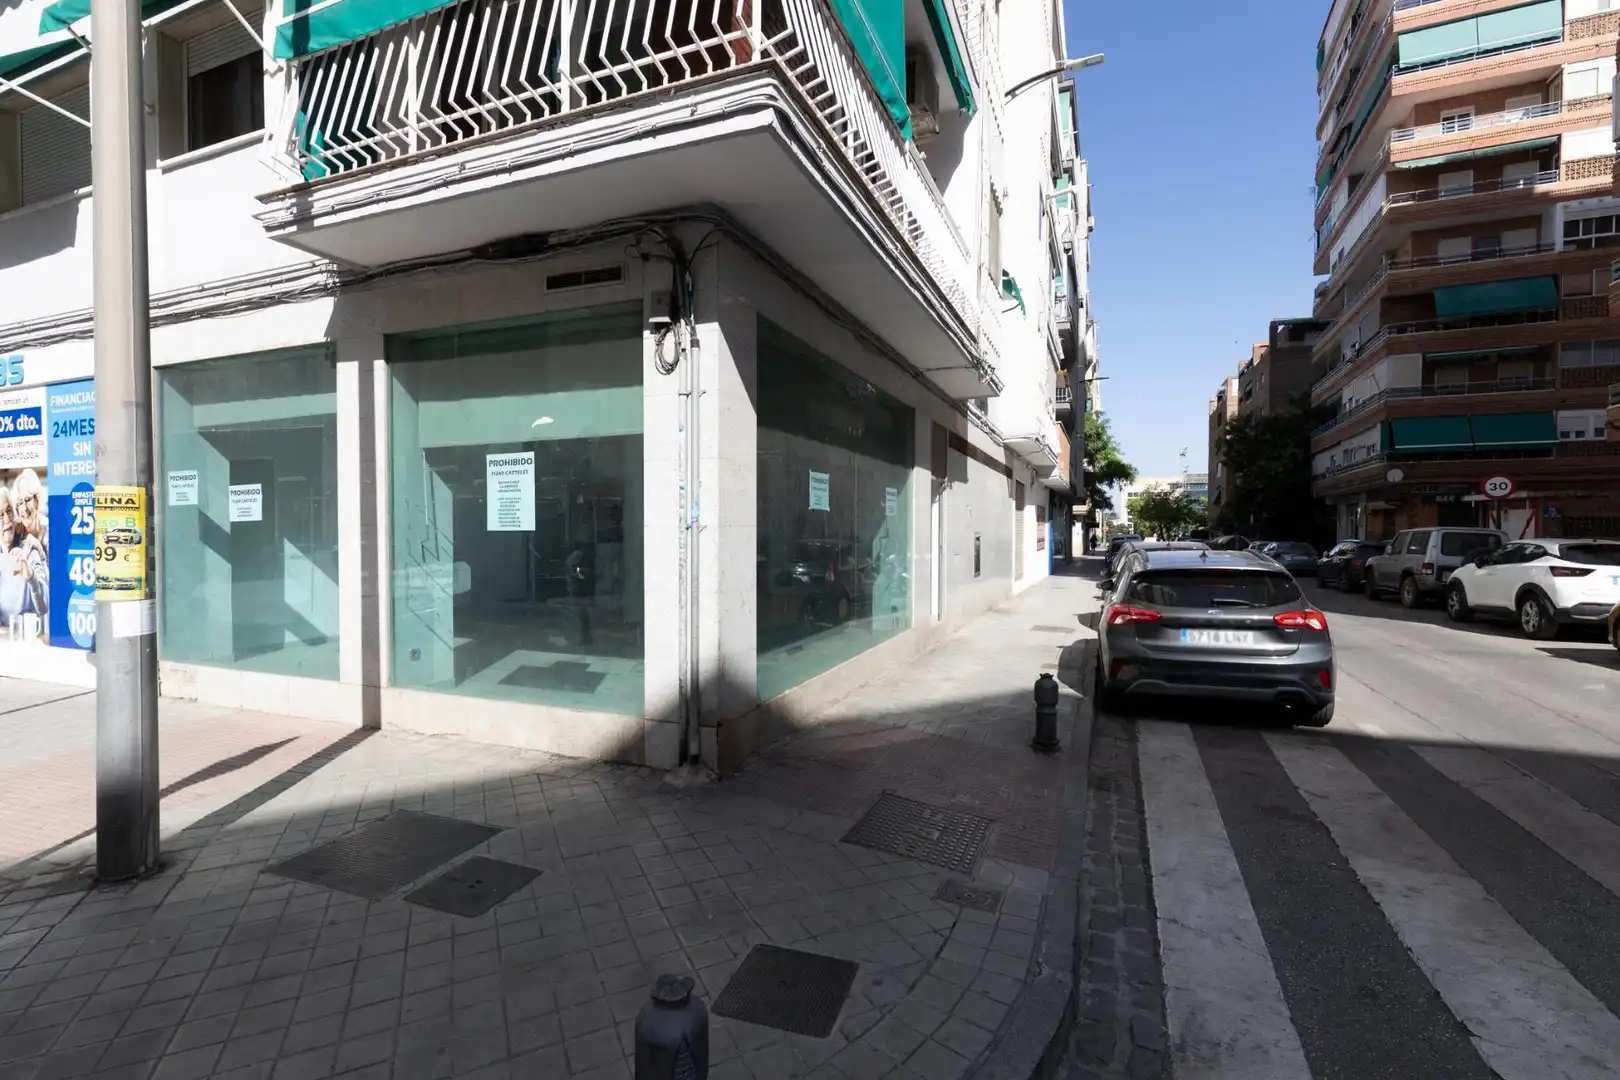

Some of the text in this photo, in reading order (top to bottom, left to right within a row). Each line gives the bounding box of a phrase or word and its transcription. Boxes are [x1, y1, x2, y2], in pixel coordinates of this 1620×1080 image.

[16, 413, 39, 431] dto.
[72, 440, 92, 457] SIN
[488, 457, 533, 467] PROHIBIDO
[1489, 482, 1508, 491] 30
